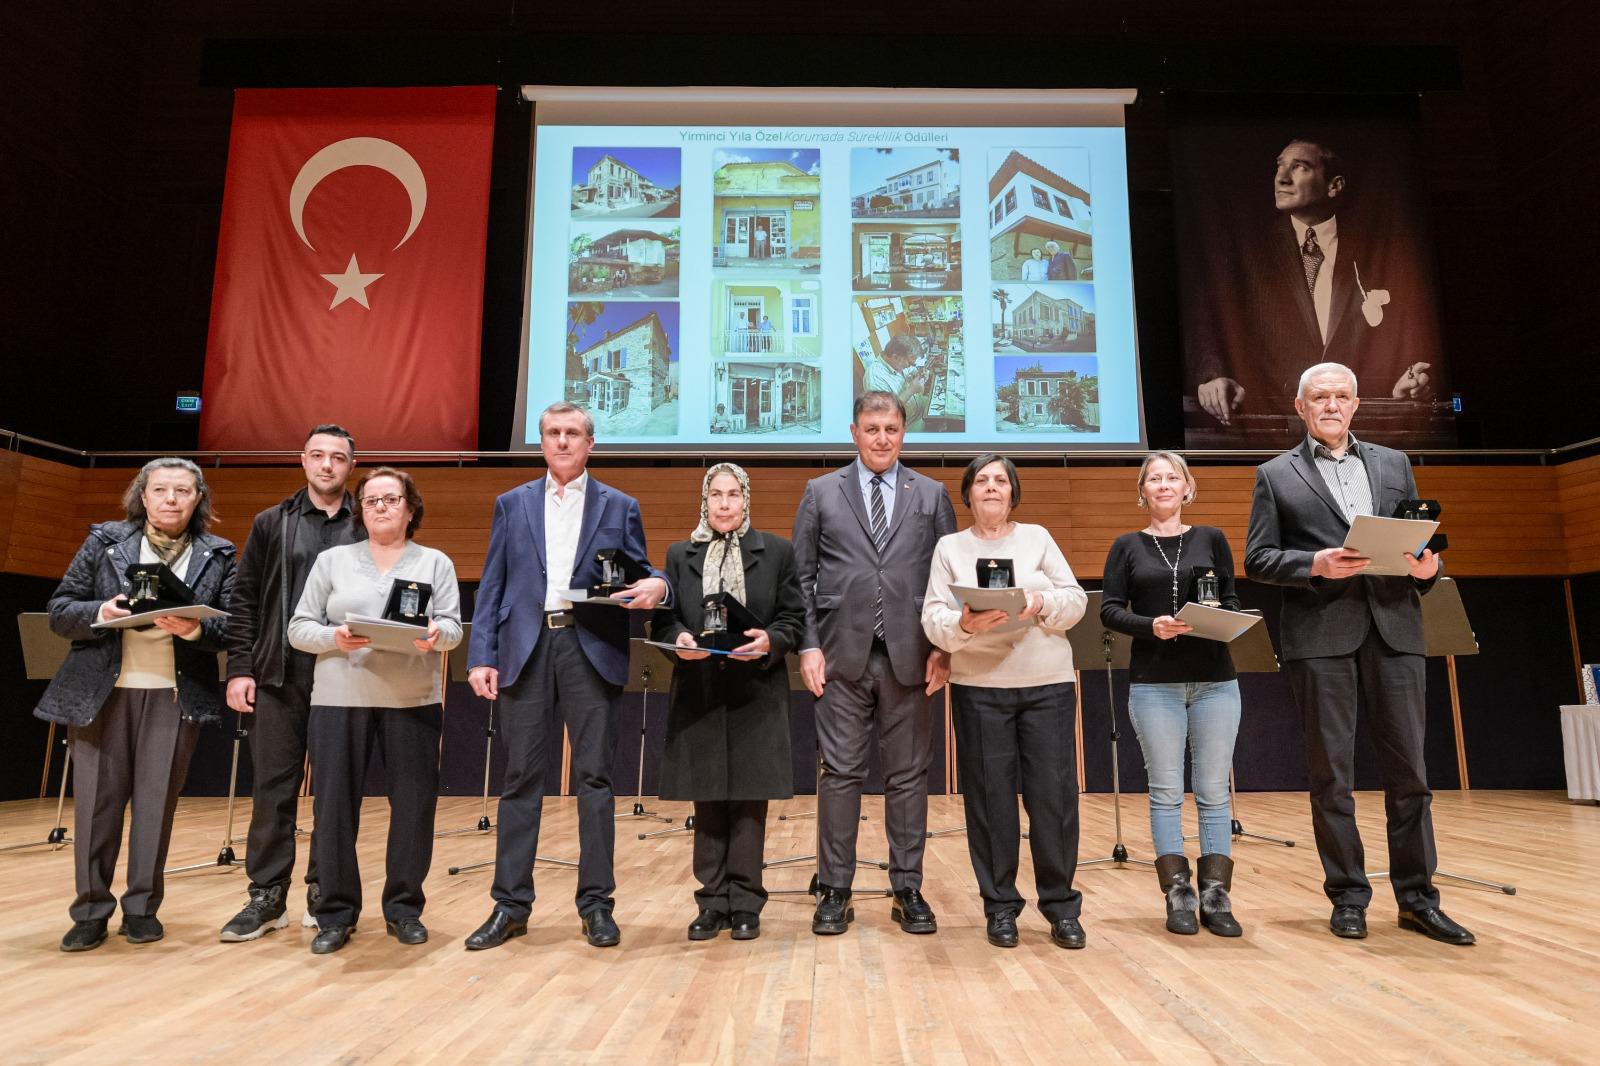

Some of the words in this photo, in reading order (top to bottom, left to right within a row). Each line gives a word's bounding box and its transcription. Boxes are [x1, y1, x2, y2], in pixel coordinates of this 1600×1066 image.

[680, 131, 725, 141] Yirminci
[730, 131, 752, 141] Yıla
[755, 130, 782, 141] Özel
[784, 131, 844, 142] Korumada
[904, 130, 948, 142] Ödülleri
